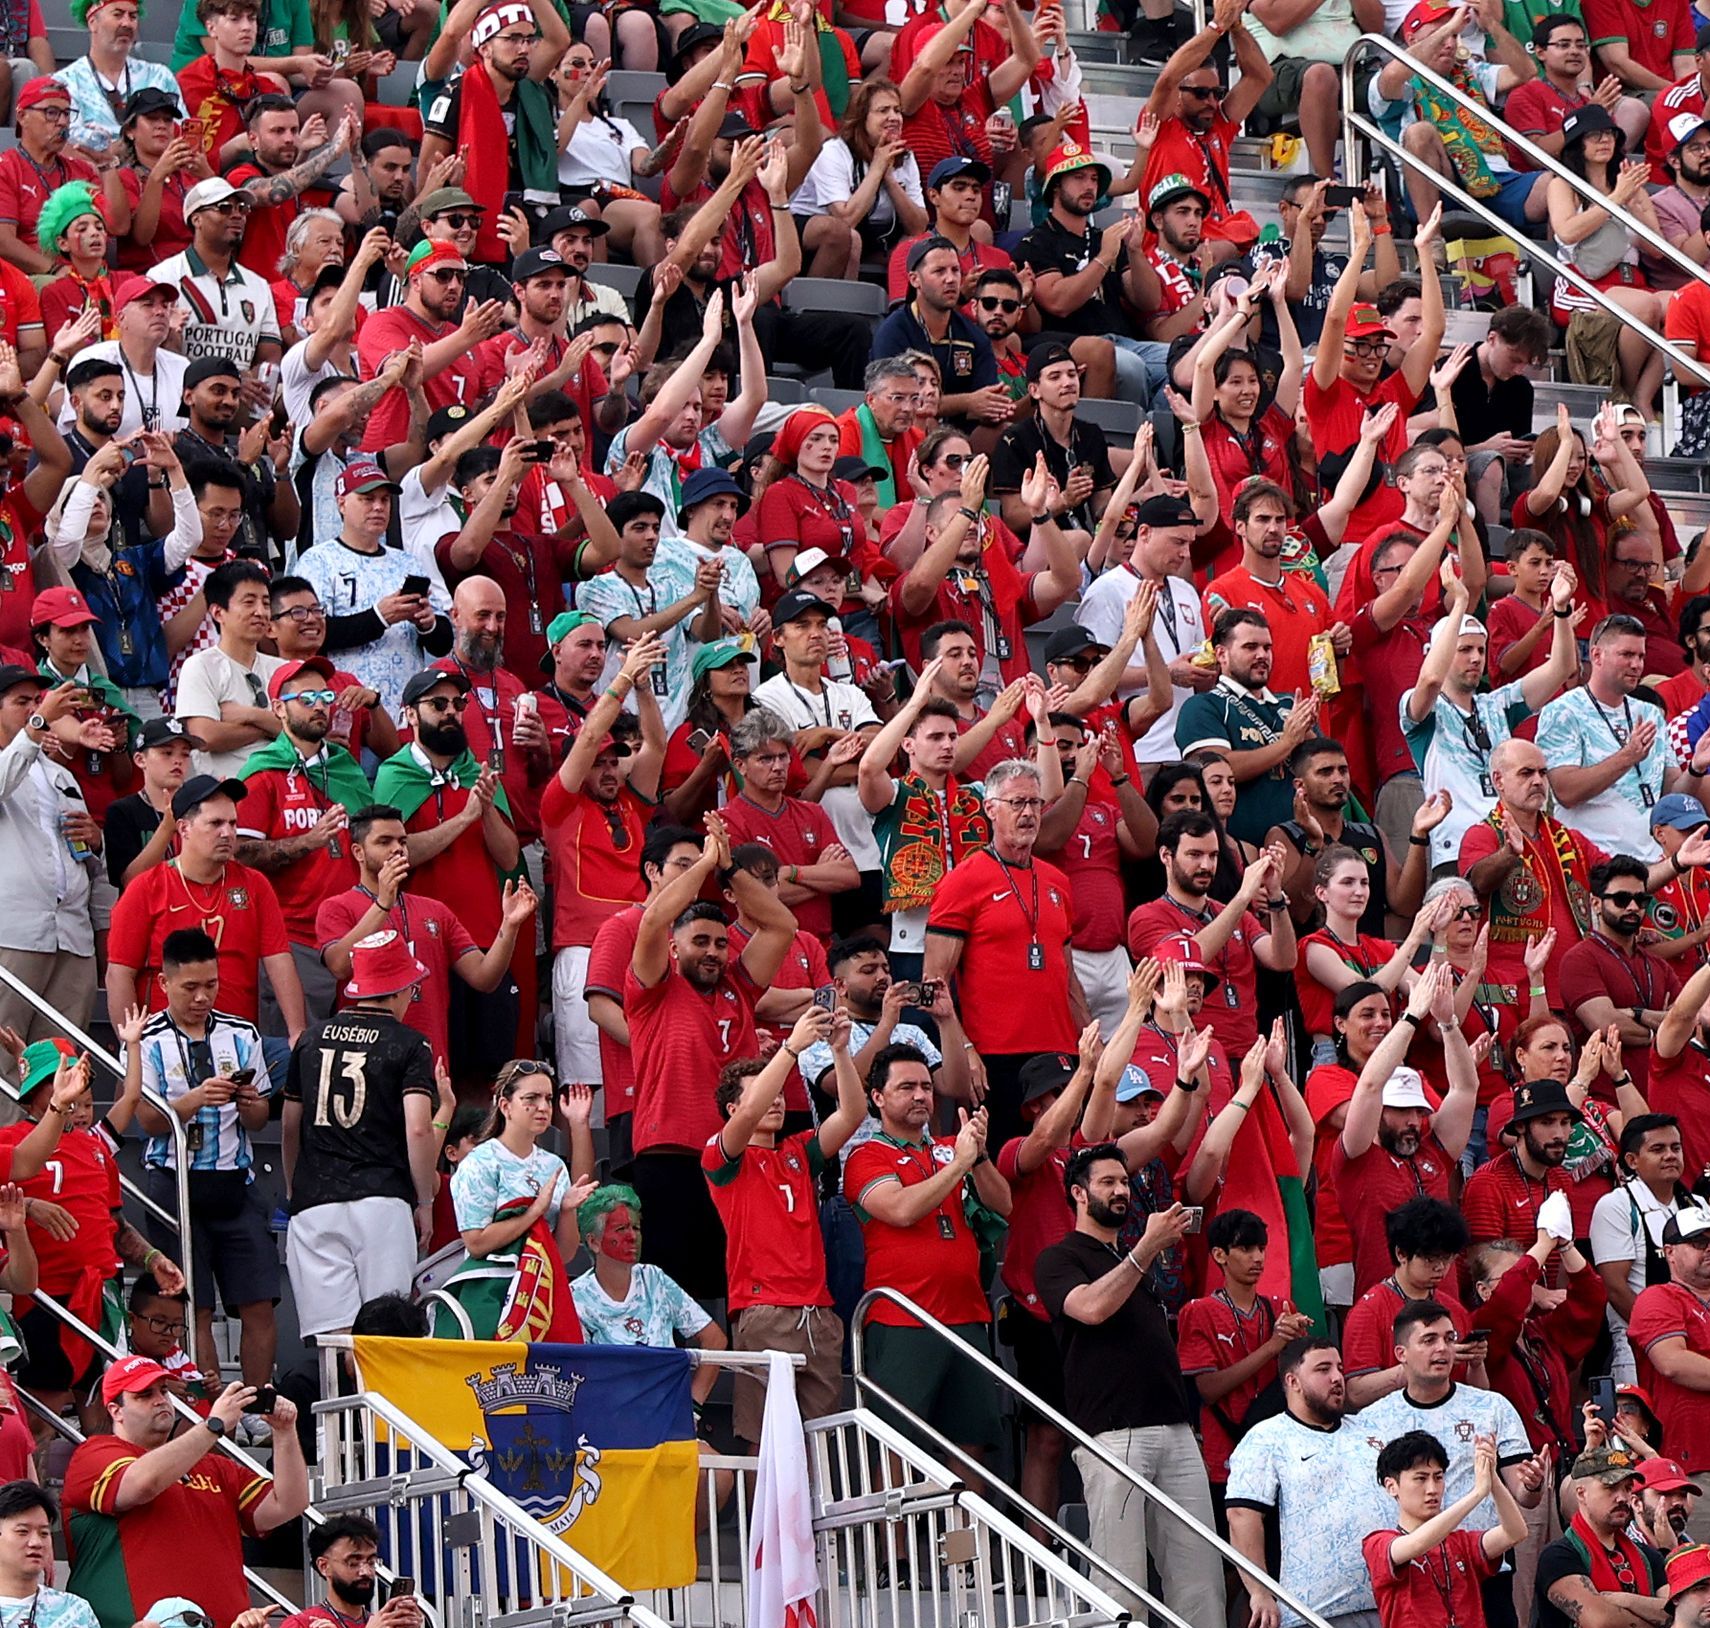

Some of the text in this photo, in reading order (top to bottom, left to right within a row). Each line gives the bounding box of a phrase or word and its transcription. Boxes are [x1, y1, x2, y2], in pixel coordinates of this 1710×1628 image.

[343, 578, 357, 607] 7
[1078, 834, 1092, 859] 7
[321, 1023, 380, 1046] EUSÉBIO
[314, 1047, 368, 1131] 13
[1126, 1065, 1144, 1085] LA
[46, 1161, 63, 1194] 7
[779, 1184, 794, 1212] 7
